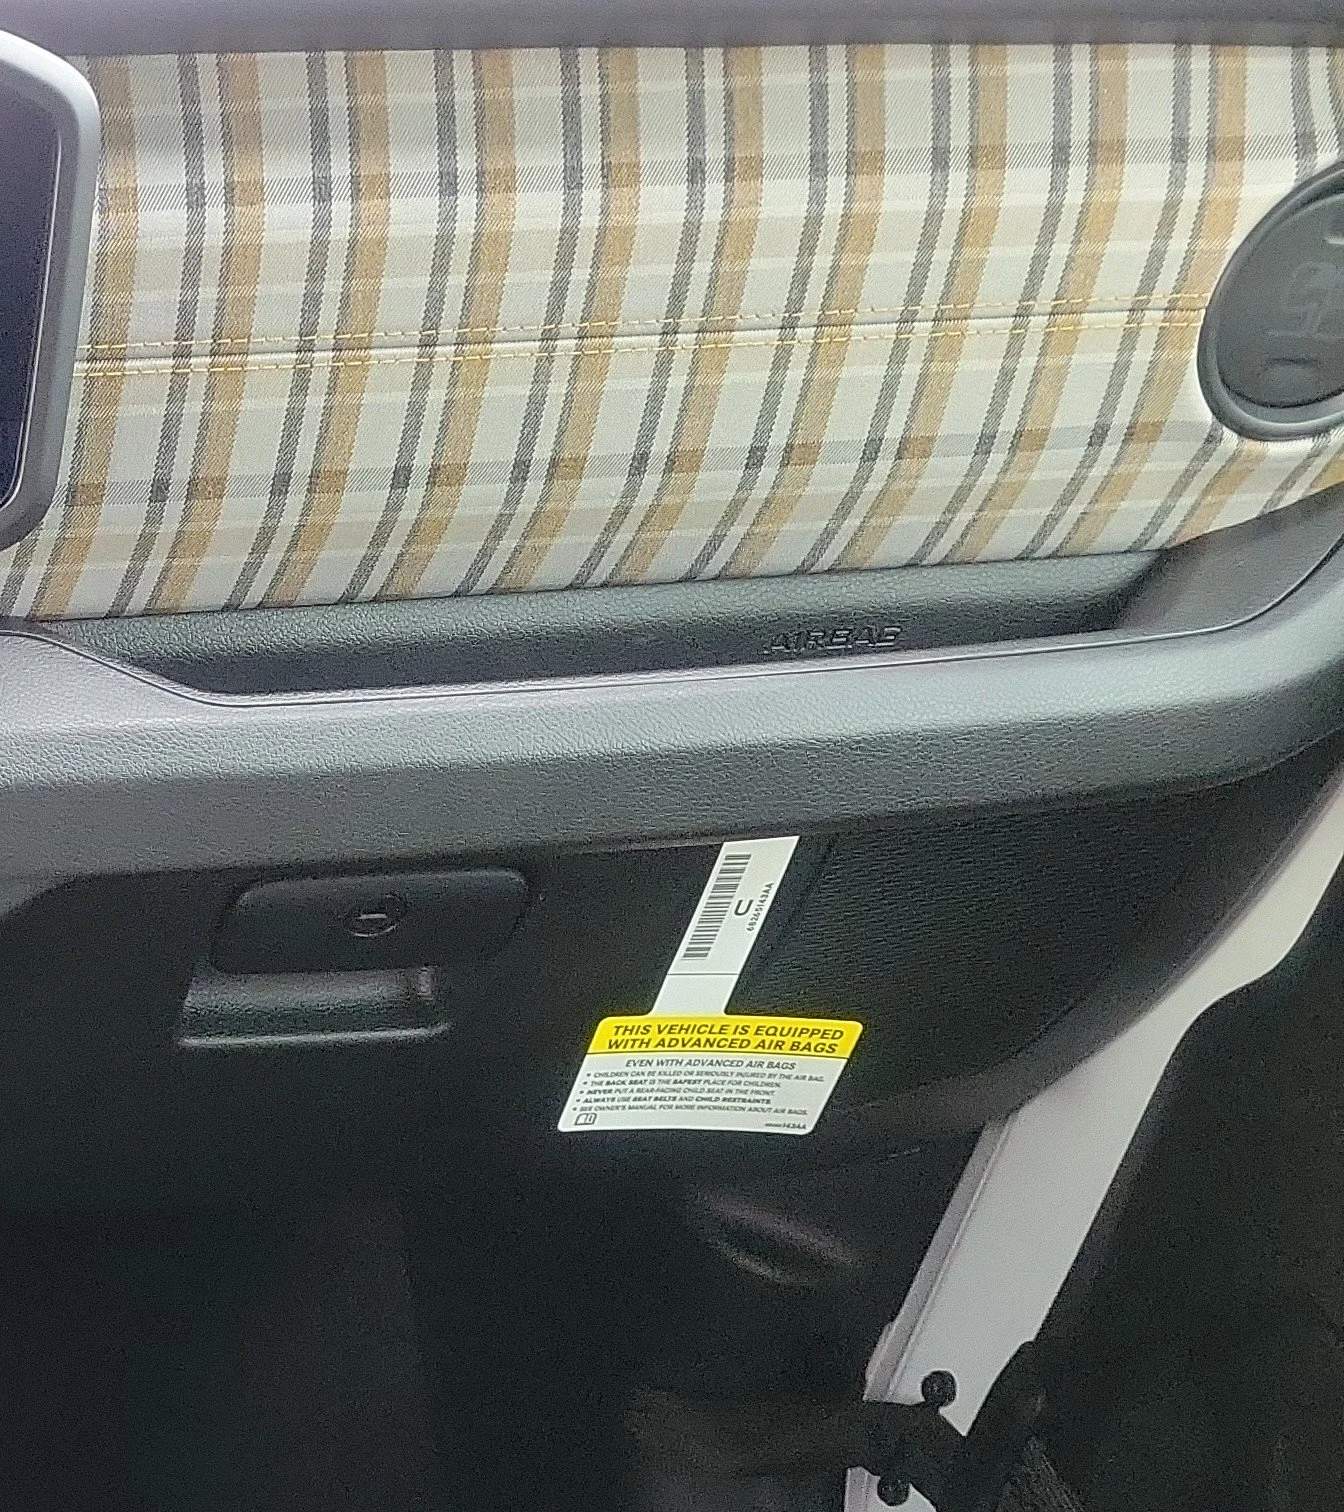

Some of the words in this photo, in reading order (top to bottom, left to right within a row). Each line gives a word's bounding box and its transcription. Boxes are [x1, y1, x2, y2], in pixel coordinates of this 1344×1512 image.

[734, 899, 754, 916] U
[613, 1024, 653, 1036] THIS
[657, 1023, 731, 1036] VEHICLE
[733, 1024, 751, 1035] IS
[754, 1025, 844, 1040] EQUIPPED
[608, 1038, 652, 1050] WITH
[653, 1037, 751, 1049] ADVANCED
[754, 1038, 785, 1051] AIR
[789, 1041, 839, 1054] BAGS
[625, 1059, 653, 1068] EVEN
[656, 1059, 683, 1067] WITH
[684, 1059, 744, 1068] ADVANCED
[745, 1060, 765, 1069] AIR
[766, 1061, 797, 1070] BAGS
[593, 1070, 629, 1078] CHILDREN
[696, 1070, 734, 1078] SERIOUSLY
[736, 1071, 766, 1079] INJURED
[778, 1072, 793, 1080] THE
[583, 1096, 616, 1104] ALWAYS
[696, 1104, 746, 1112] INFORMATION
